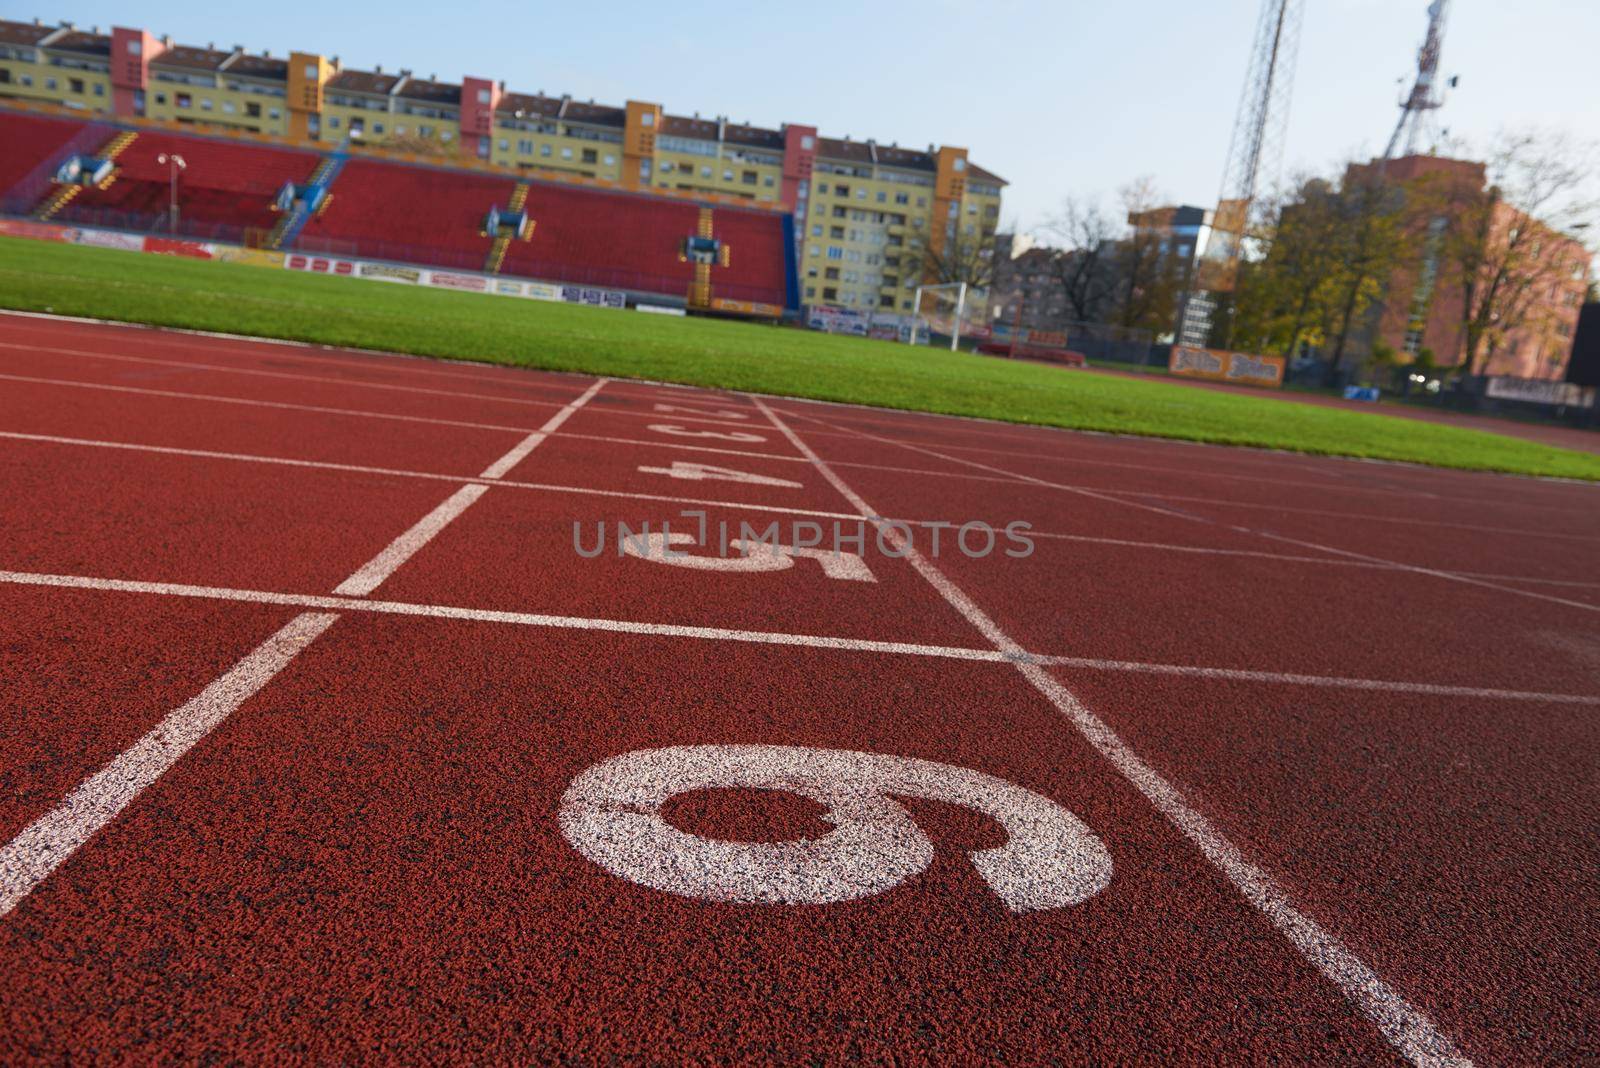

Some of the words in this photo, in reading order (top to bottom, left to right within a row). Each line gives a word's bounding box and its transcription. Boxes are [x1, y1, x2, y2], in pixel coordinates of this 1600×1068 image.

[653, 403, 750, 420] 2
[646, 424, 768, 443] 3
[637, 461, 804, 489] 4
[622, 532, 878, 583] 5
[558, 743, 1113, 914] 6
